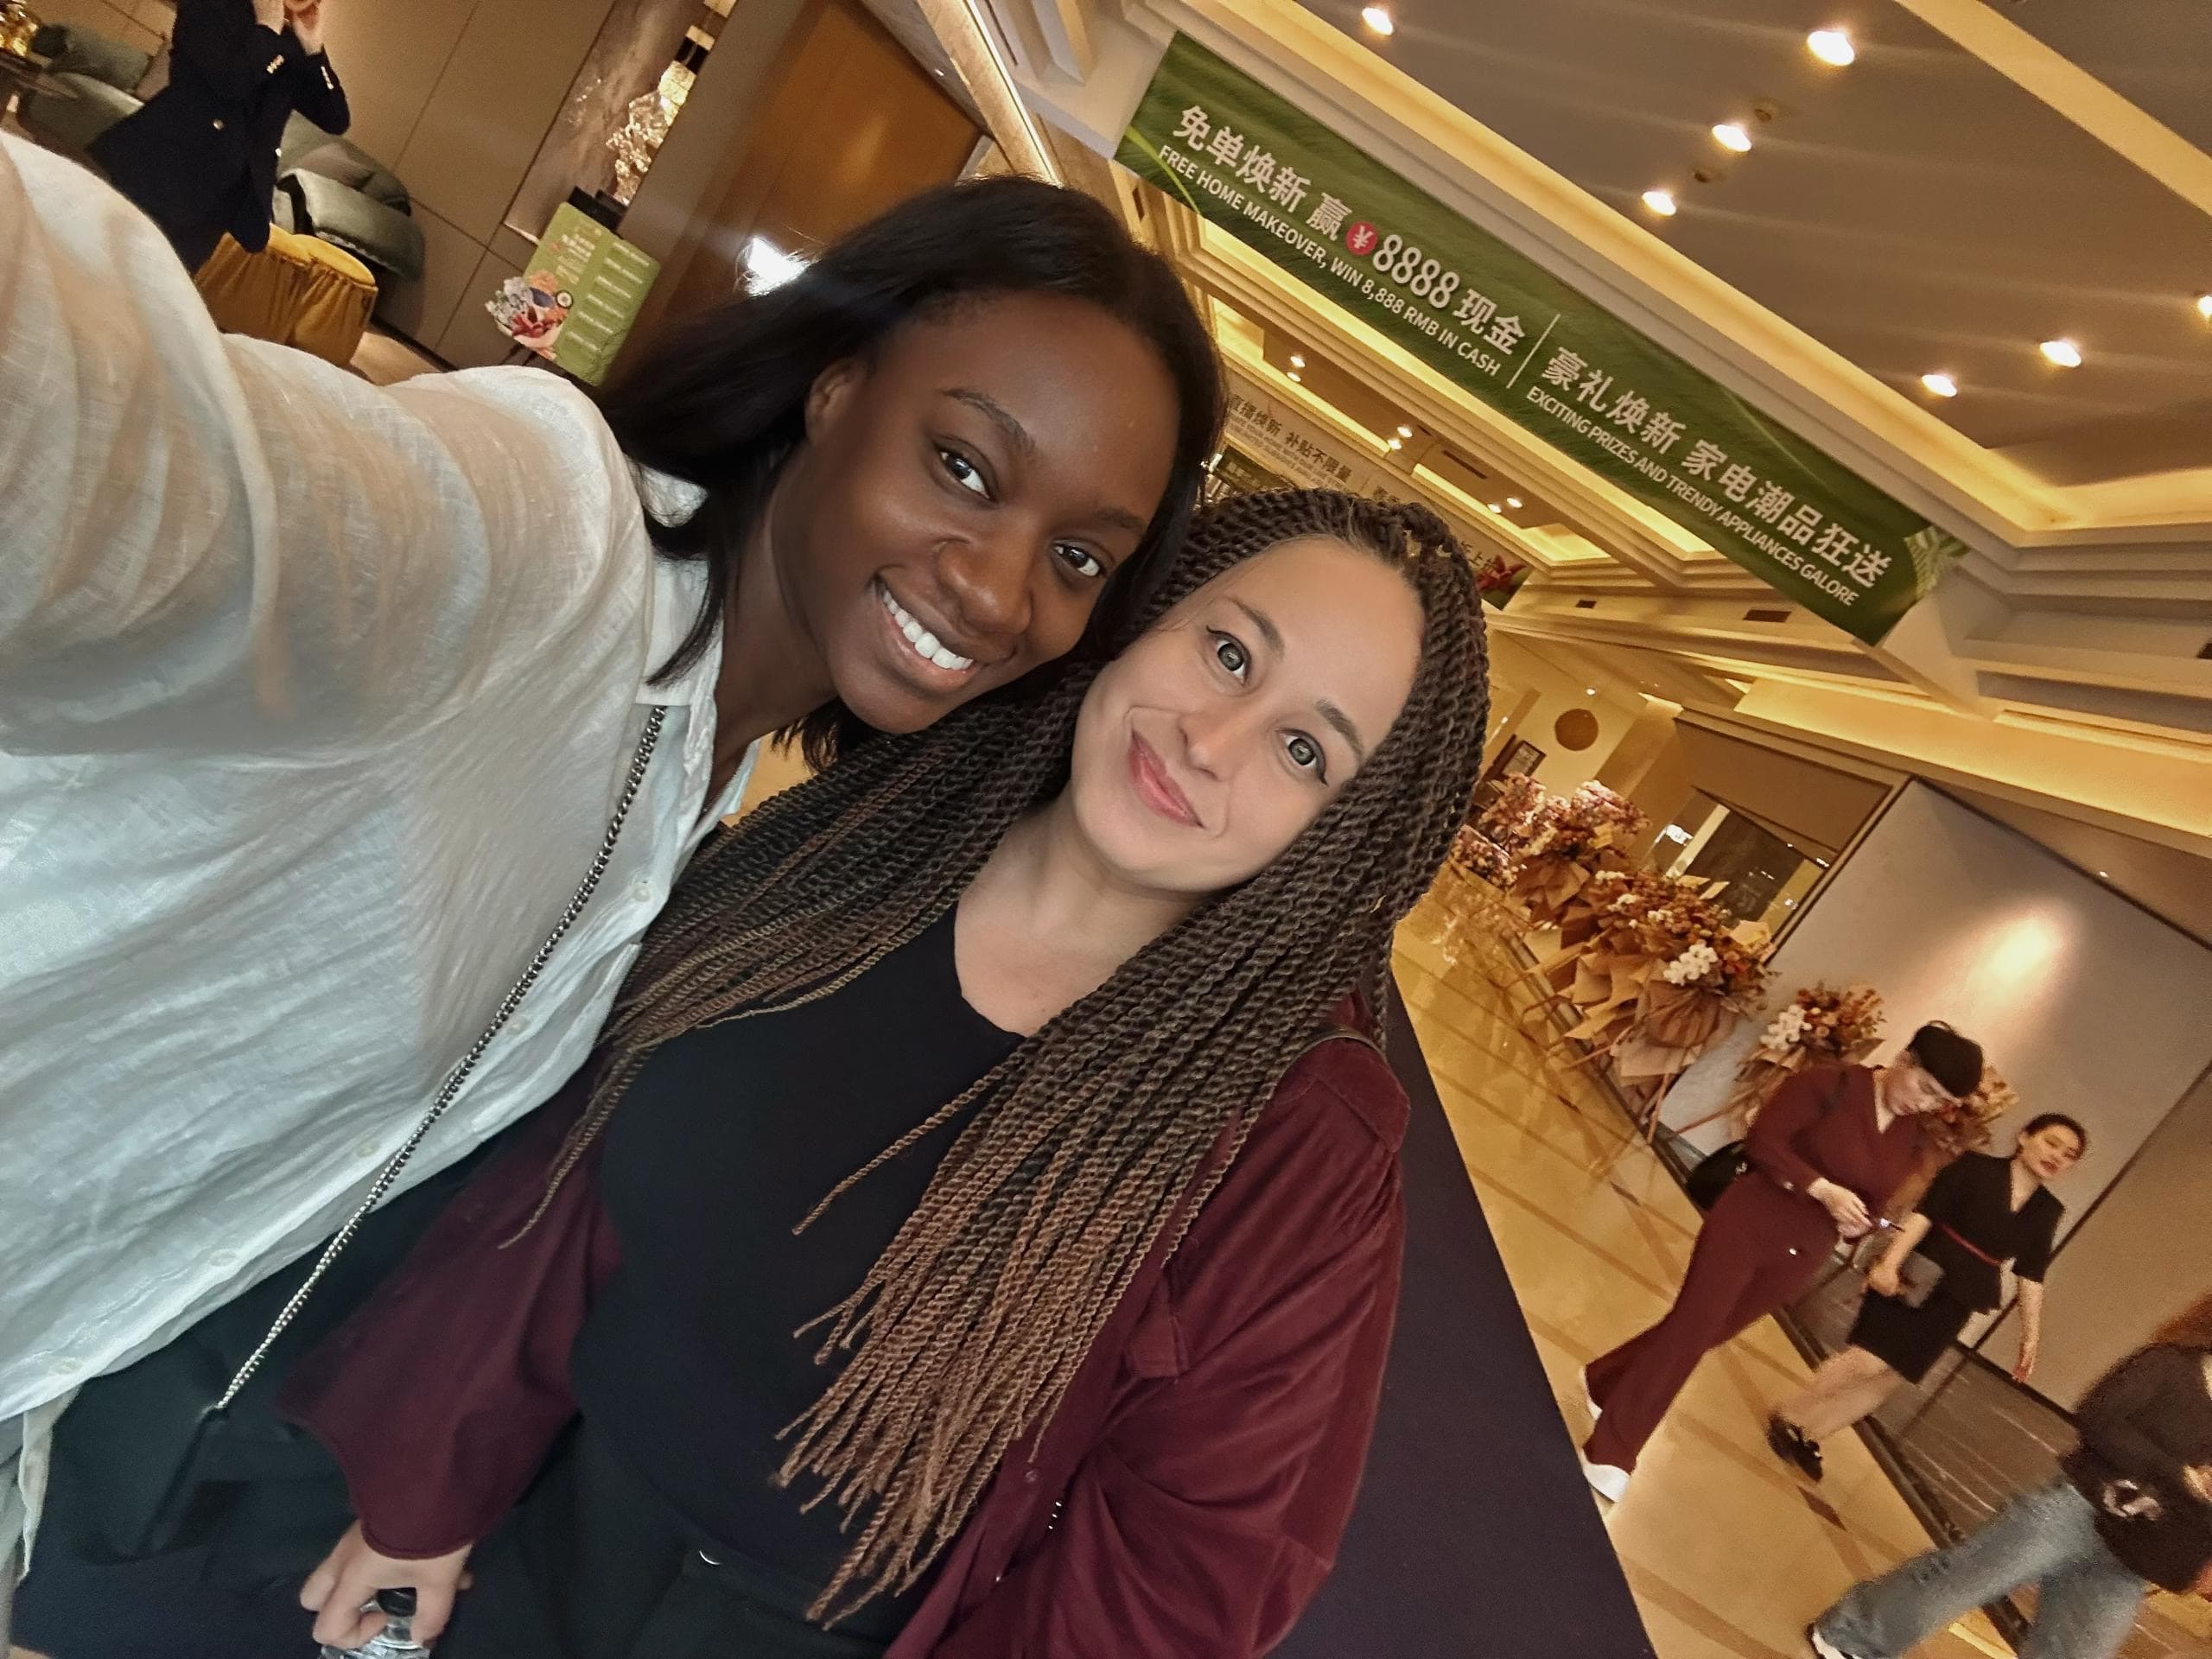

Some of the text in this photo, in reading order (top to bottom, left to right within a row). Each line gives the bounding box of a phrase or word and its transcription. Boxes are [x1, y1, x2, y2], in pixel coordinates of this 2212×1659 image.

[1160, 144, 1501, 376] FREE HOME MAKEOVER, WIN 8,888 RMB IN CASH
[1173, 105, 1312, 213] 免单焕新
[1526, 385, 1860, 606] EXCITING PRIZES AND TRENDY APPLIANCES GALORE
[1541, 346, 1892, 588] 豪礼焕新 家电潮品狂送
